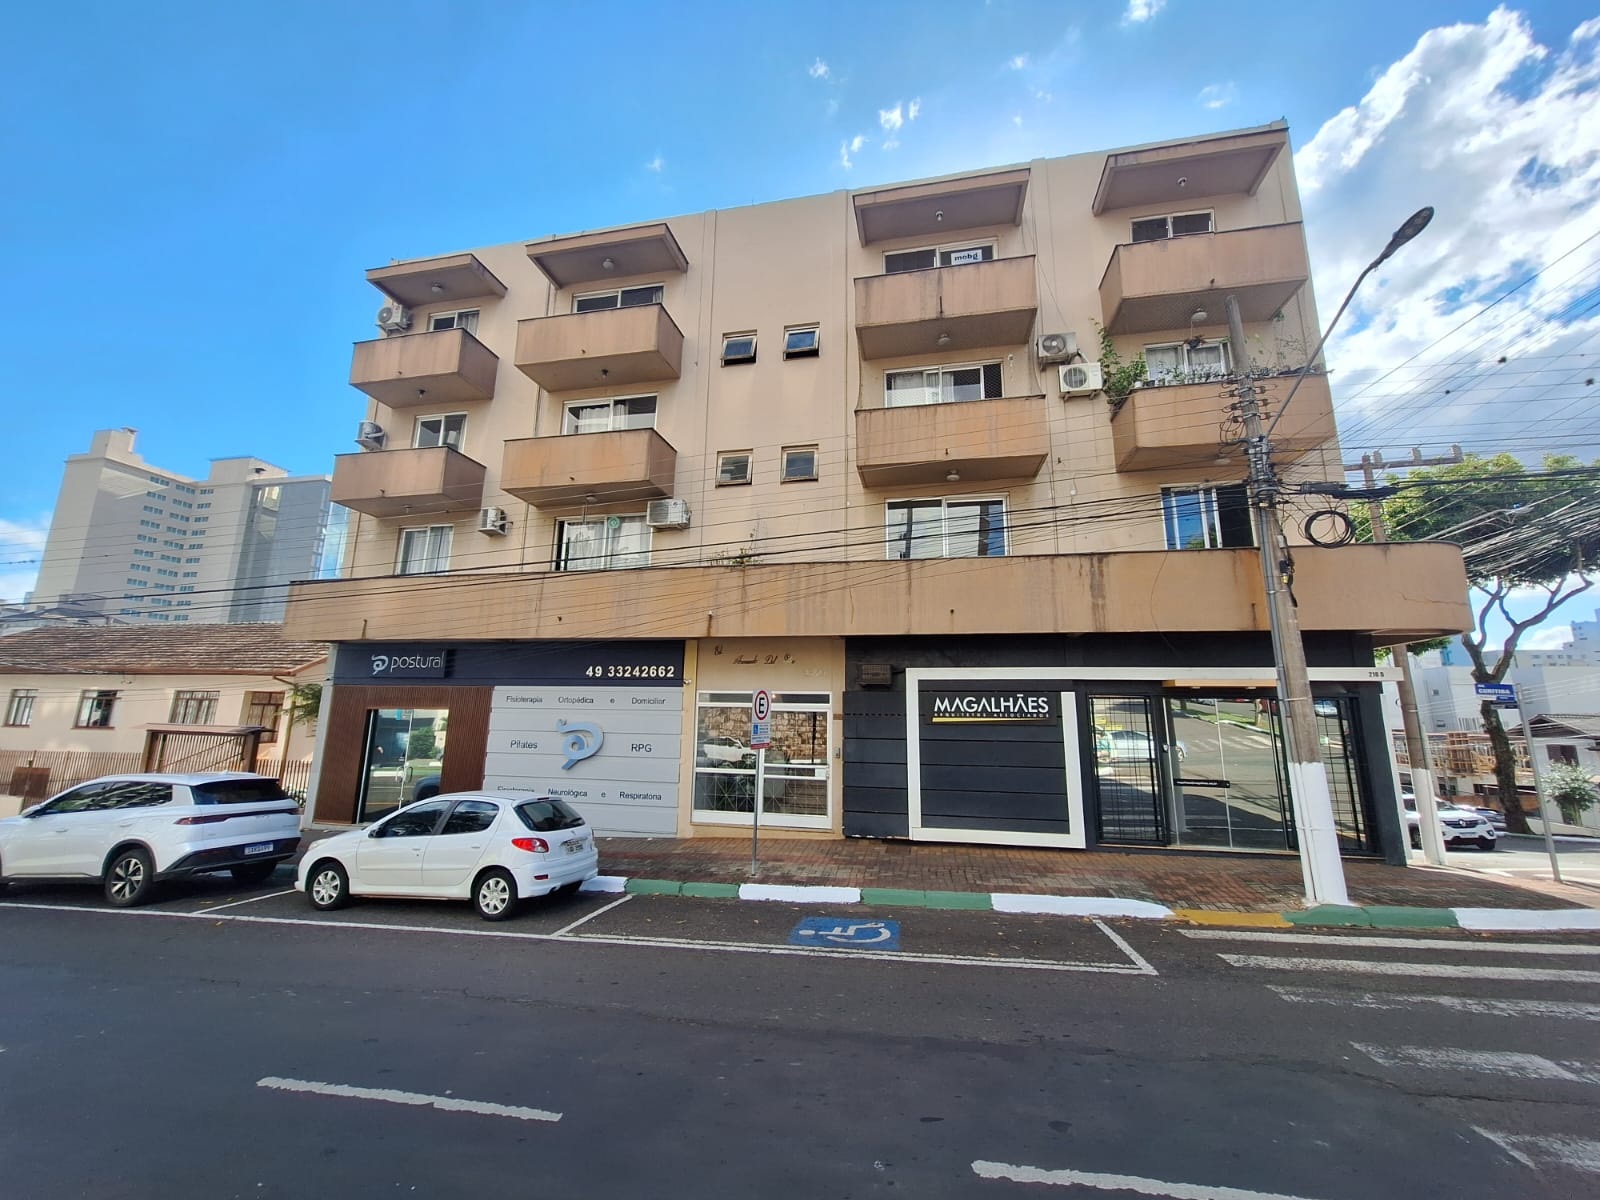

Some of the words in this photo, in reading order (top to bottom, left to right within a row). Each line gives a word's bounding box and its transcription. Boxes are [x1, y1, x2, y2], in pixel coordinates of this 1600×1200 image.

[390, 650, 446, 673] postural
[585, 665, 603, 678] 49
[607, 665, 675, 678] 33242662
[506, 695, 543, 704] Fisioterapia
[558, 695, 594, 704] Ortopédica
[631, 696, 667, 705] Domiciliar
[758, 696, 766, 714] E
[933, 693, 1049, 713] MAGALHÃES
[510, 739, 538, 749] Pilates
[631, 743, 652, 753] RPG
[547, 788, 588, 798] Neurológica
